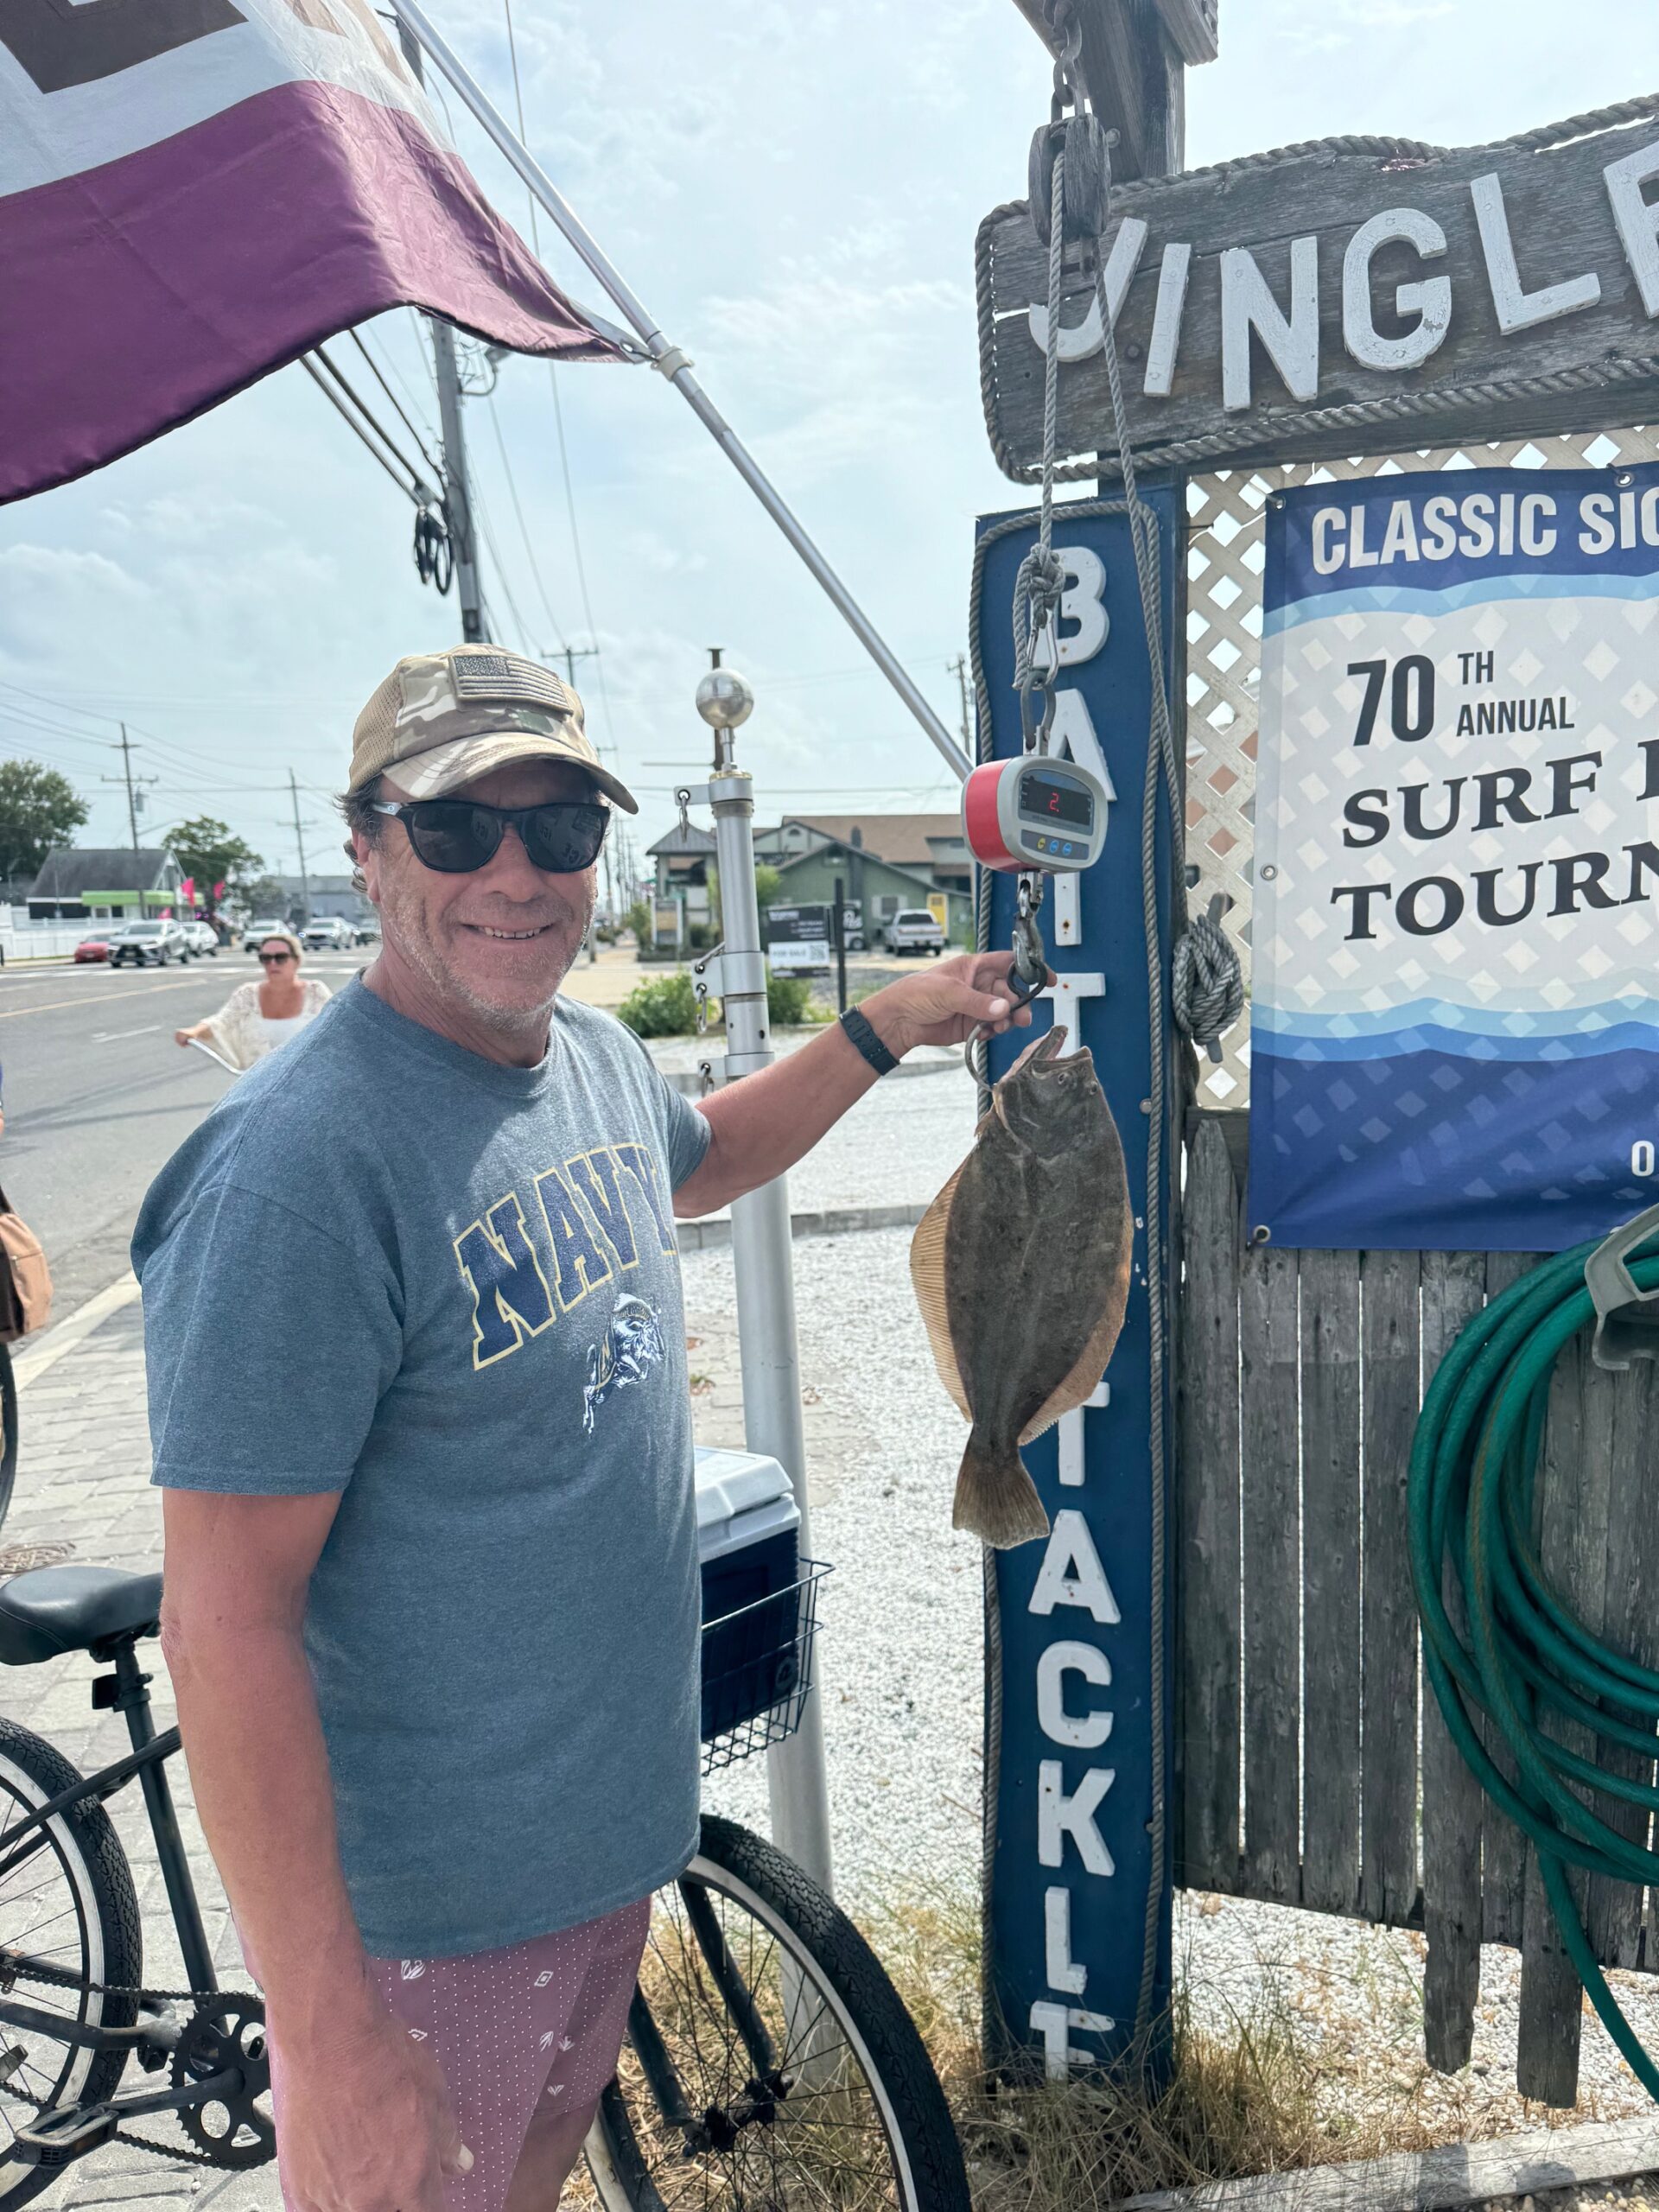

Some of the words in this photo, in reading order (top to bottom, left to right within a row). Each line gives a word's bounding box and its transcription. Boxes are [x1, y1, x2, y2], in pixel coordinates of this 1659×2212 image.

[1312, 493, 1557, 575] CLASSIC
[1347, 654, 1435, 747] 70
[1458, 650, 1494, 685] TH
[1456, 696, 1575, 737] ANNUAL
[1343, 750, 1603, 849] SURF
[453, 1141, 678, 1370] NAVY
